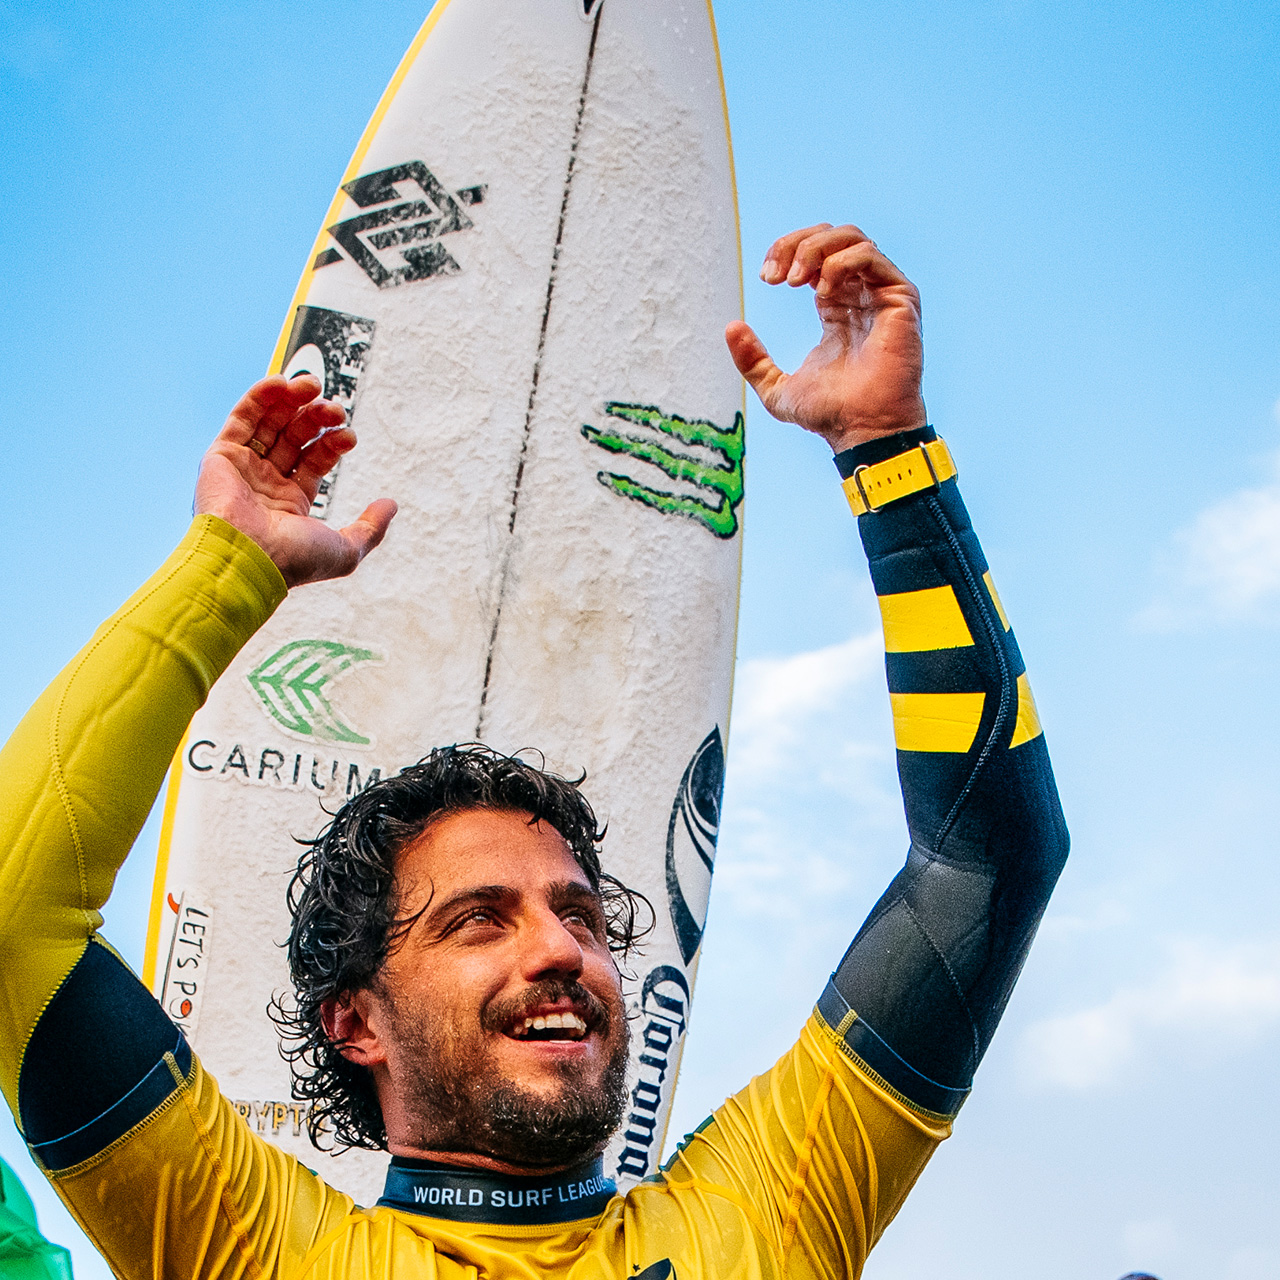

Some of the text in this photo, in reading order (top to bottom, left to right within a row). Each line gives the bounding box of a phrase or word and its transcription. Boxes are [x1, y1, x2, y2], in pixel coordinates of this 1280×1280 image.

[188, 739, 382, 801] CARIUM
[177, 905, 209, 969] LET'S
[615, 964, 690, 1180] Corona
[413, 1173, 607, 1208] WORLD SURF LEAGUE
